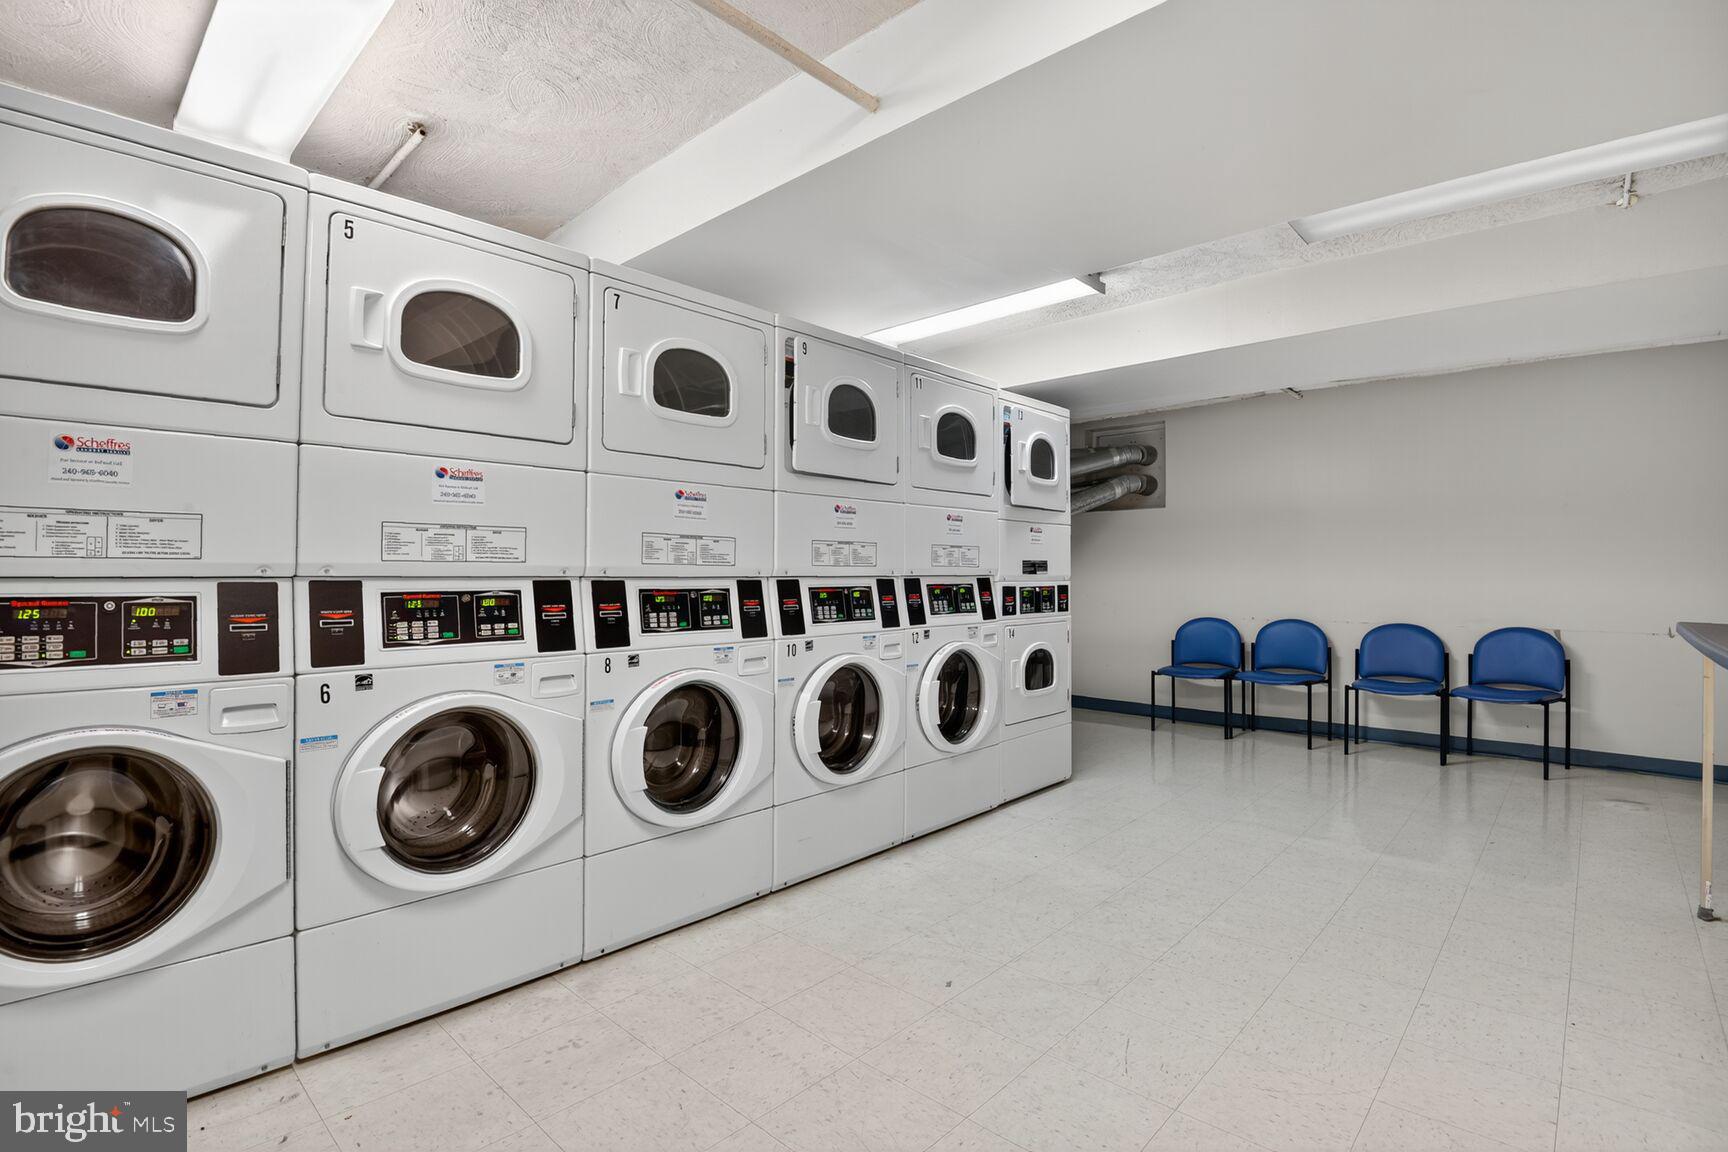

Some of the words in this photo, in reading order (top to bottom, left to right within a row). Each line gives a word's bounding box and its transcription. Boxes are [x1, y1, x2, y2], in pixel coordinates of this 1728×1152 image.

[344, 220, 354, 240] 5
[613, 293, 621, 310] 7
[802, 341, 808, 355] 9
[915, 377, 922, 389] 11
[77, 437, 131, 449] Scheffres
[911, 632, 919, 644] 12
[787, 643, 797, 657] 10
[605, 657, 611, 674] 8
[320, 683, 331, 704] 6
